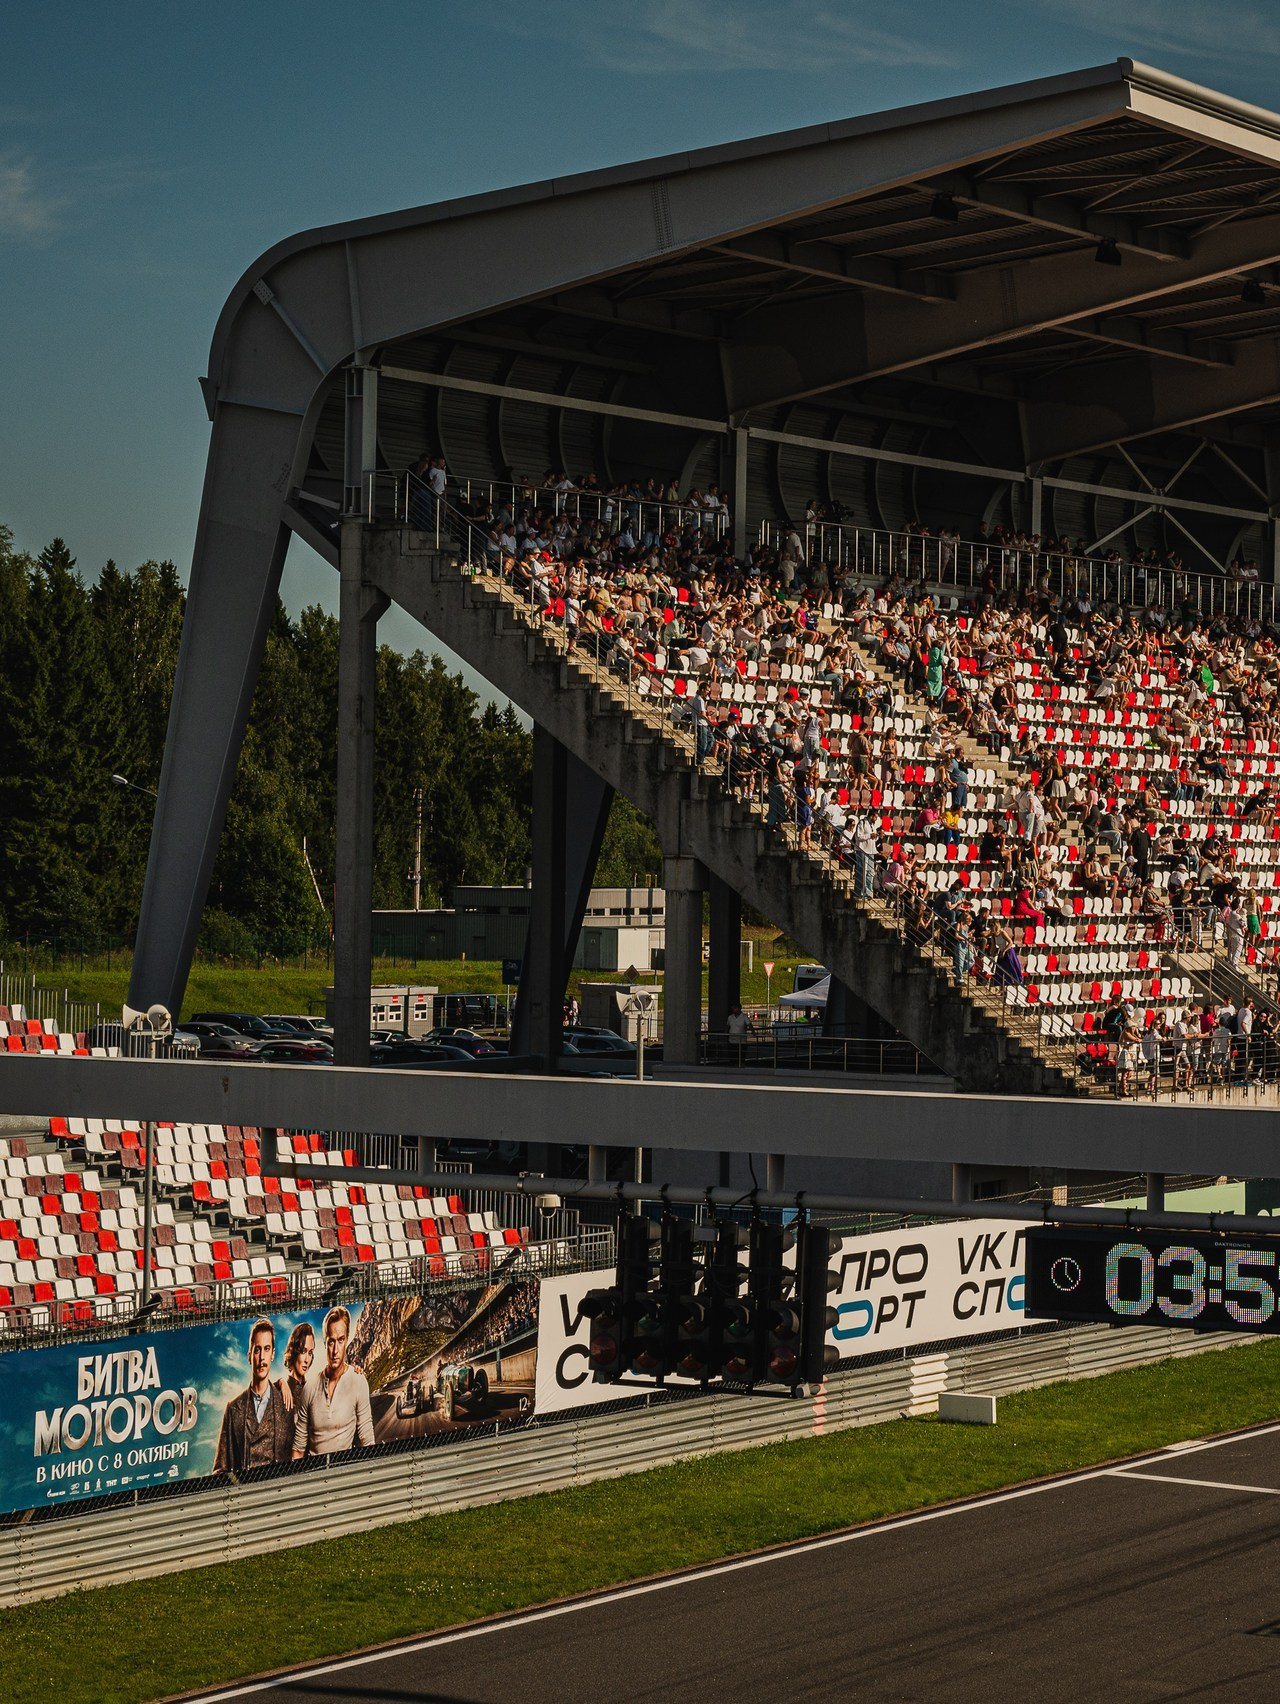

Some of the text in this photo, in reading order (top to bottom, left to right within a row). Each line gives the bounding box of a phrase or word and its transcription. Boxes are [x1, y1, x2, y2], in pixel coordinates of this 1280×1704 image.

[836, 1243, 929, 1295] ПРО
[958, 1231, 1007, 1275] VK
[832, 1290, 926, 1341] ОРТ
[953, 1275, 1025, 1320] СПО
[77, 1346, 161, 1401] БИТВА
[34, 1387, 198, 1457] МОТОРОВ
[519, 1397, 531, 1411] 12+
[36, 1441, 189, 1483] В КИНО С 8 ОКТЯБРЯ
